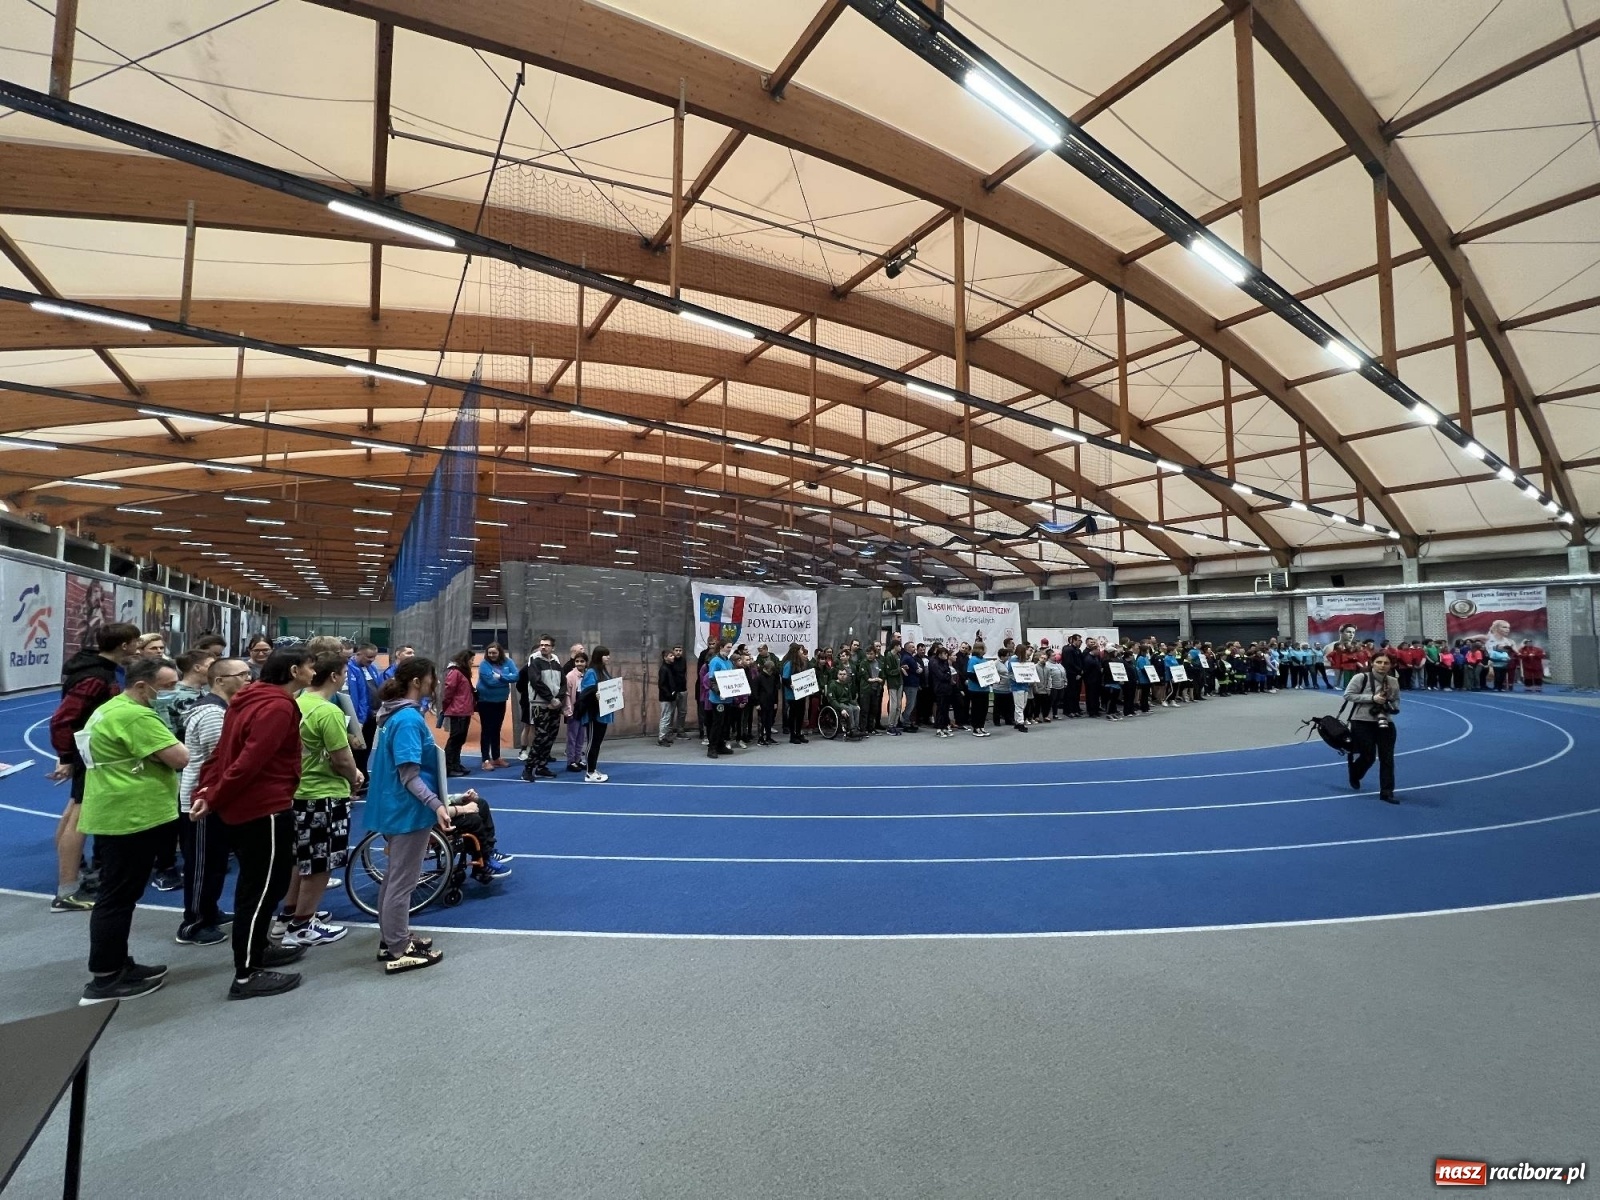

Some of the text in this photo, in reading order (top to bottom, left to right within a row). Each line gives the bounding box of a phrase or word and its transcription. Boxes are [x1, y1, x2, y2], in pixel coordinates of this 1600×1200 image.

[748, 603, 811, 615] STAROSTWO
[966, 604, 1011, 615] LEKKOATLETYCZNY
[747, 618, 811, 629] POWIATOWE
[746, 633, 811, 643] W RACIBORZU
